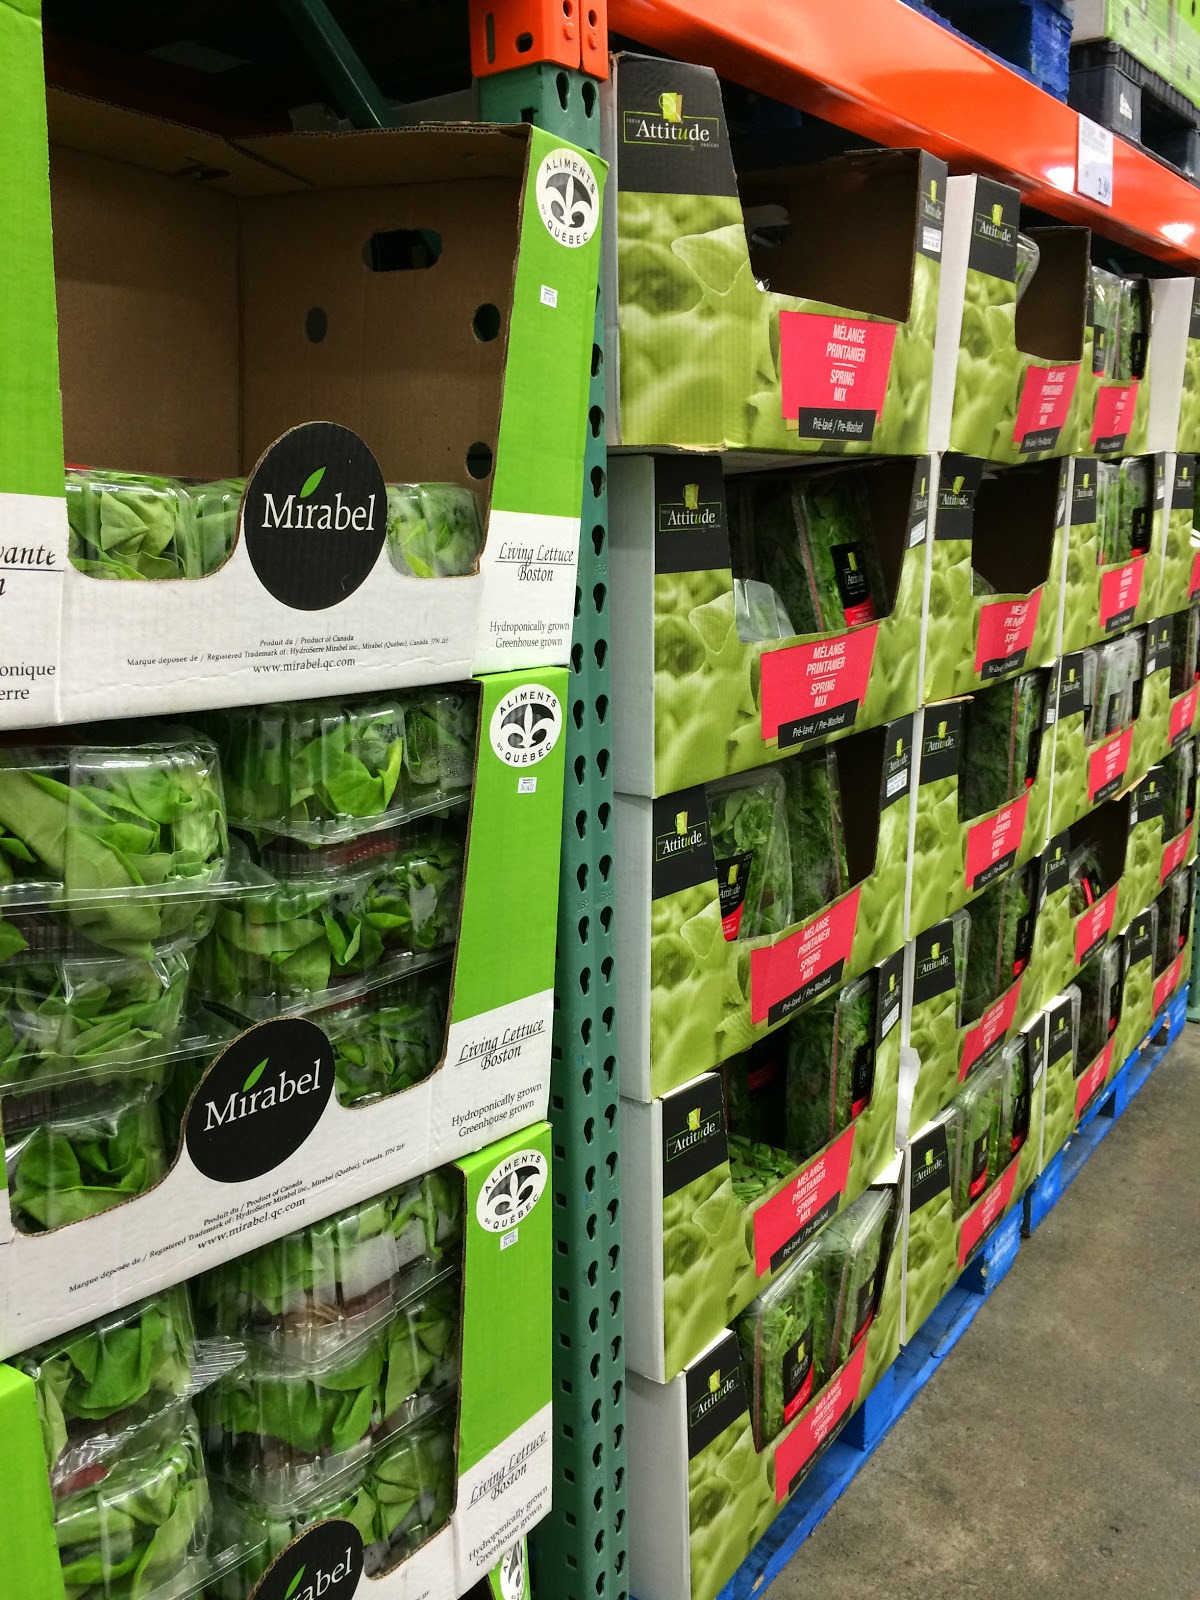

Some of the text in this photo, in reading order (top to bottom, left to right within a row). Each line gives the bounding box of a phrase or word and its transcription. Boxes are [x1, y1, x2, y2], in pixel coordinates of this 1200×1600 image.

[635, 120, 710, 142] Attitude
[546, 158, 596, 194] ALIMENTS
[547, 219, 589, 244] QUÉBEC
[979, 220, 1012, 243] Attitude
[832, 322, 866, 344] MÉLANGE
[826, 342, 866, 363] PRINTANIER
[830, 369, 856, 386] SPRING
[833, 387, 848, 402] MIX
[261, 492, 376, 531] Mirabel
[667, 508, 716, 526] Attitude
[498, 542, 574, 567] Living Lettuce
[517, 563, 554, 582] Boston
[284, 638, 294, 646] du
[300, 636, 324, 644] Product
[332, 634, 354, 642] Canada
[490, 620, 570, 636] Hydroponically grown
[206, 652, 242, 662] Registered
[244, 648, 278, 658] Trademark
[326, 644, 348, 652] Mirabel
[495, 636, 563, 650] Greenhouse grown
[813, 642, 846, 660] MÉLANGE
[253, 658, 356, 673] www.mirabel.qc.com
[806, 656, 846, 676] PRINTANIER
[810, 679, 836, 696] SPRING
[500, 691, 557, 716] ALIMENTS
[814, 694, 828, 708] MIX
[505, 742, 552, 763] QUÉBEC
[927, 736, 954, 752] Attitude
[662, 830, 702, 855] Attitude
[803, 915, 830, 942] MÉLANGE
[797, 928, 830, 958] PRINTANIER
[800, 950, 822, 972] SPRING
[802, 964, 815, 981] MIX
[920, 954, 949, 974] Attitude
[458, 1019, 544, 1062] Living Lettuce
[480, 1045, 522, 1071] Boston
[203, 1057, 321, 1132] Mirabel
[452, 1083, 542, 1127] Hydroponically grown
[458, 1099, 535, 1138] Greenhouse grown
[673, 1121, 716, 1154] Attitude
[485, 1154, 542, 1194] ALIMENTS
[796, 1158, 826, 1190] MÉLANGE
[917, 1158, 942, 1182] Attitude
[792, 1168, 826, 1205] PRINTANIER
[203, 1211, 229, 1227] Produit
[230, 1207, 239, 1216] du
[246, 1192, 271, 1208] Product
[272, 1188, 280, 1198] of
[280, 1180, 303, 1194] Canada
[493, 1194, 540, 1230] QUÉBEC
[796, 1190, 818, 1217] SPRING
[800, 1206, 812, 1224] MIX
[69, 1276, 98, 1293] Marque
[100, 1262, 130, 1280] déposée
[132, 1256, 140, 1266] de
[149, 1236, 186, 1258] Registered
[188, 1221, 224, 1242] Trademark
[236, 1202, 272, 1222] HydroSerre
[273, 1190, 297, 1205] Mirabel
[311, 1172, 334, 1188] Mirabel
[197, 1198, 306, 1250] www.mirabel.qc.com
[696, 1379, 735, 1418] Attitude
[470, 1430, 546, 1505] Living Lettuce
[490, 1462, 528, 1501] Boston
[468, 1506, 524, 1562] Hydroponically
[526, 1485, 548, 1509] grown
[476, 1525, 520, 1567] Greenhouse
[520, 1502, 543, 1529] grown
